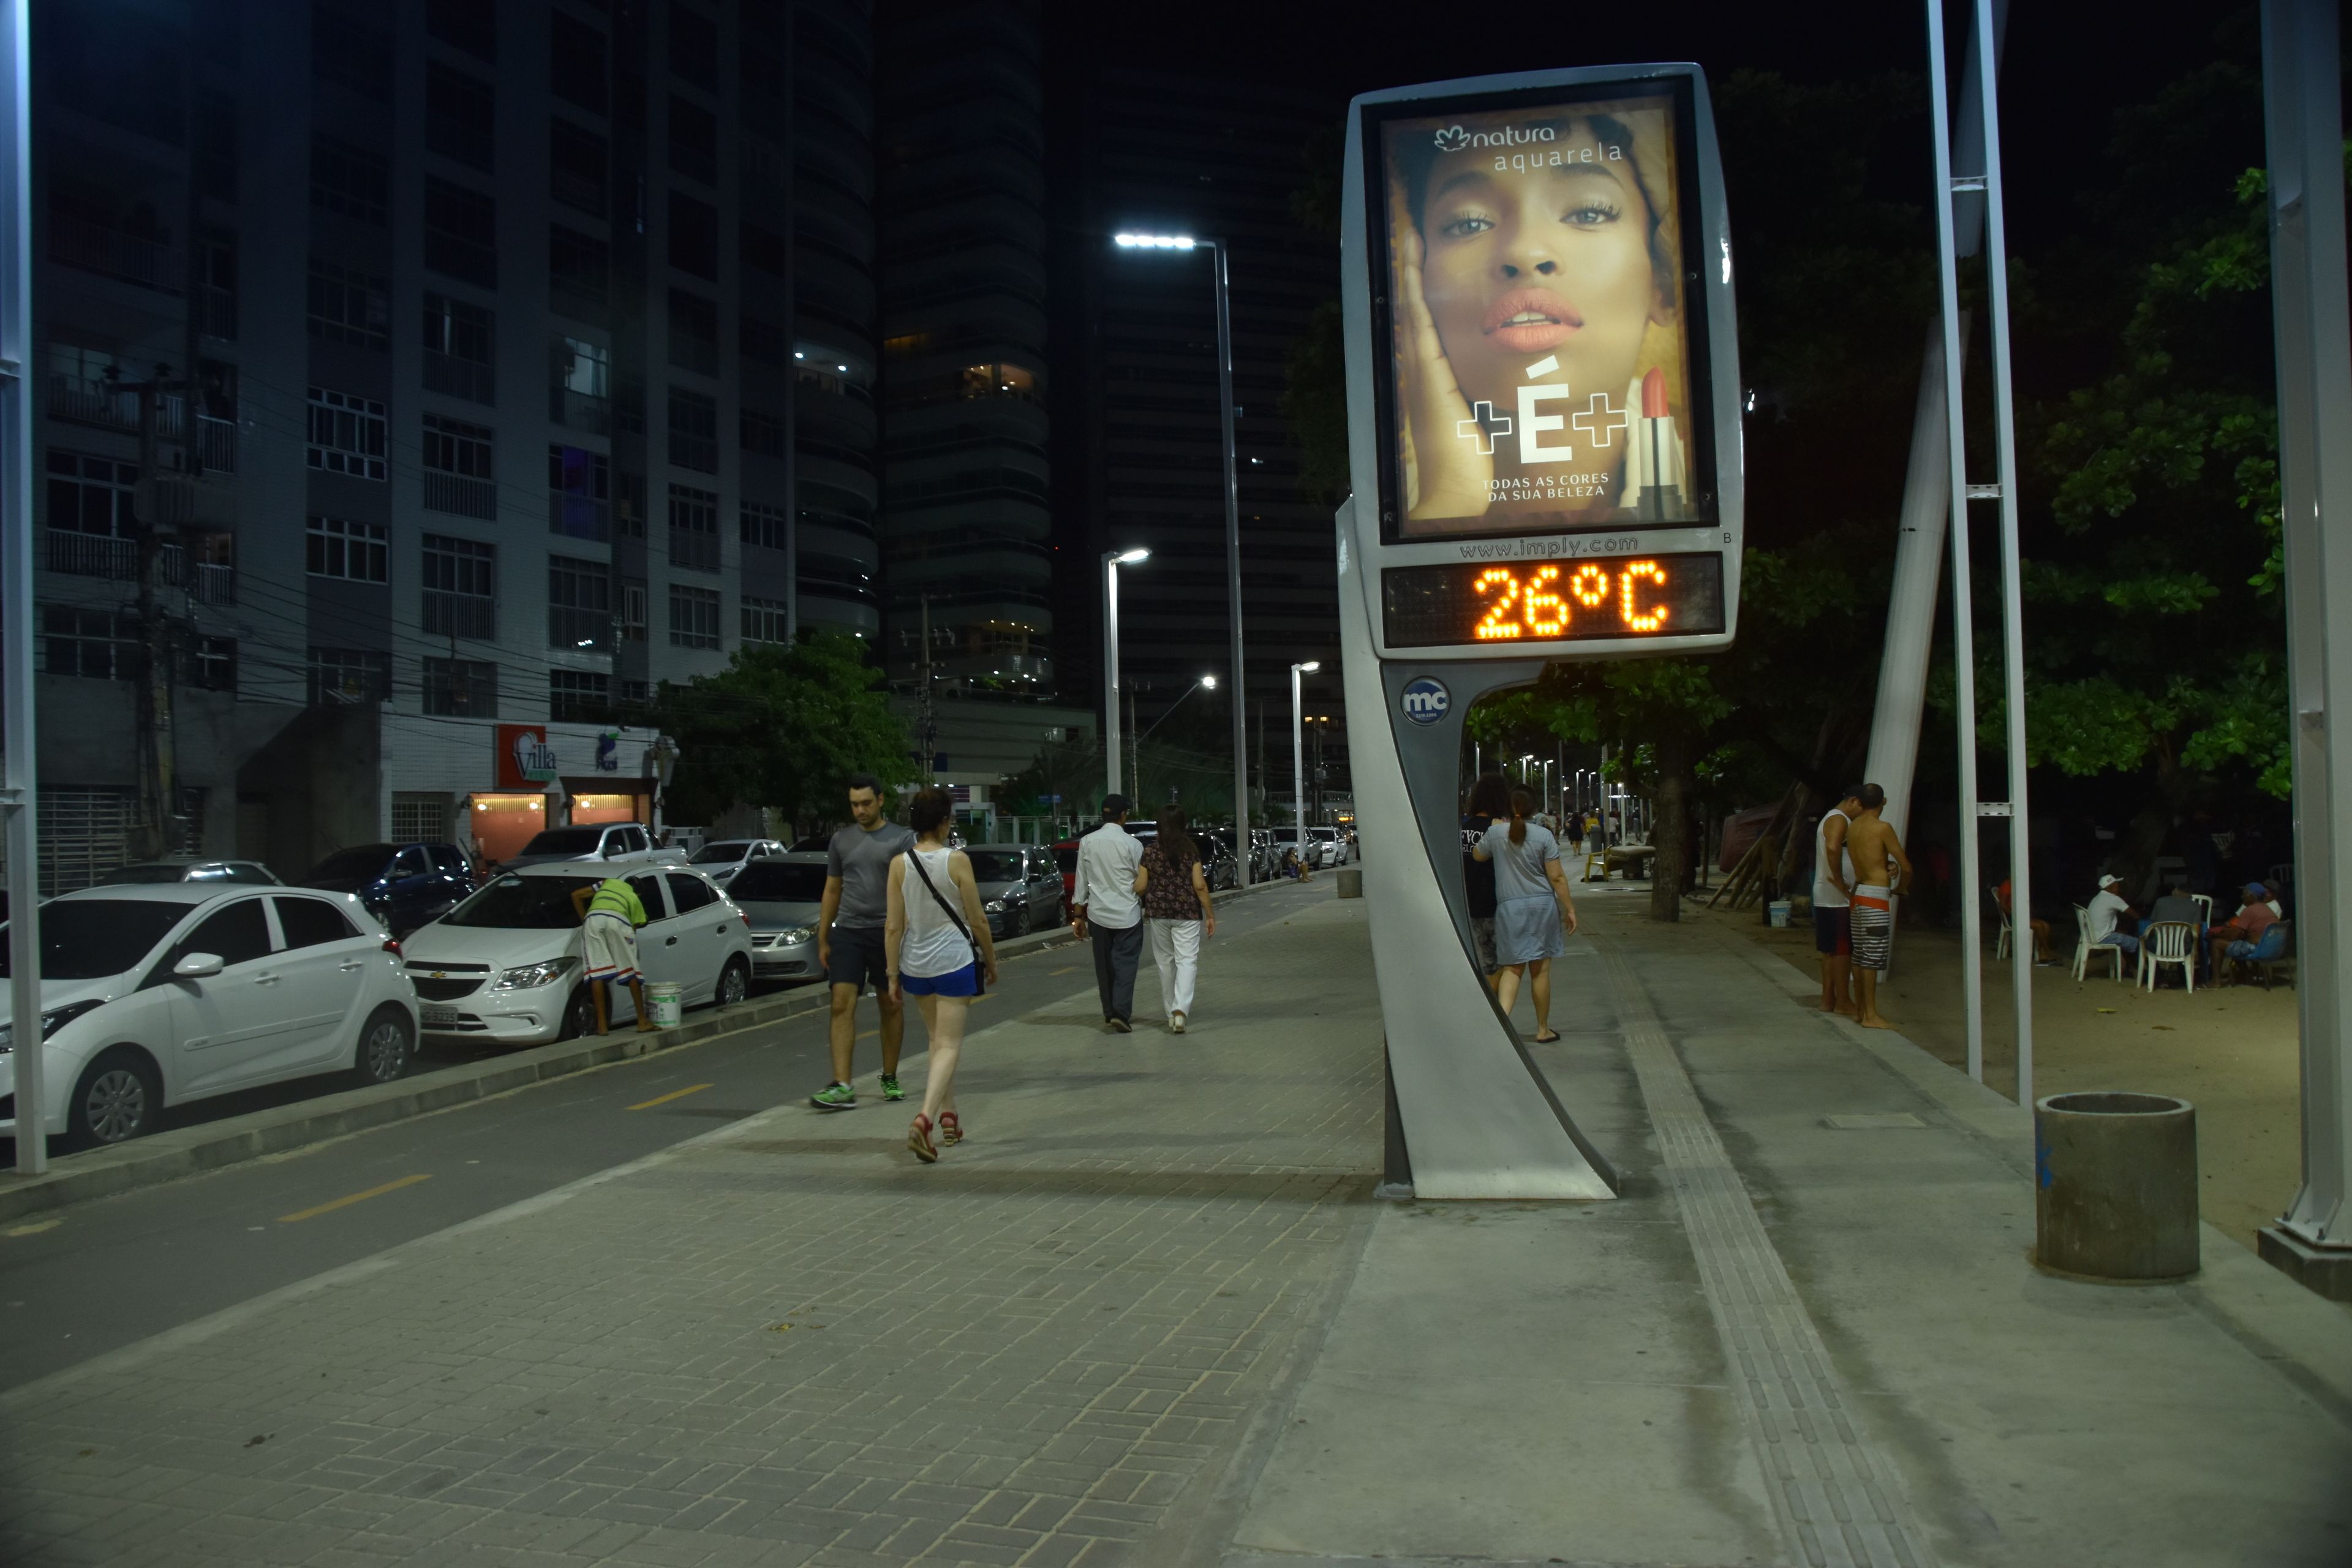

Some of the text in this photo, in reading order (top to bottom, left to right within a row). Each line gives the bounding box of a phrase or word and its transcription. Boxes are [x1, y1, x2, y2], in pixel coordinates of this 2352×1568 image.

[1473, 126, 1555, 147] natura
[1494, 142, 1622, 173] aquarela
[1482, 473, 1608, 490] TODAS AS CORES
[1488, 486, 1604, 502] DA SUA BELEZA
[1460, 537, 1638, 558] www.imply.com
[1724, 532, 1732, 543] B
[1404, 691, 1447, 712] mc
